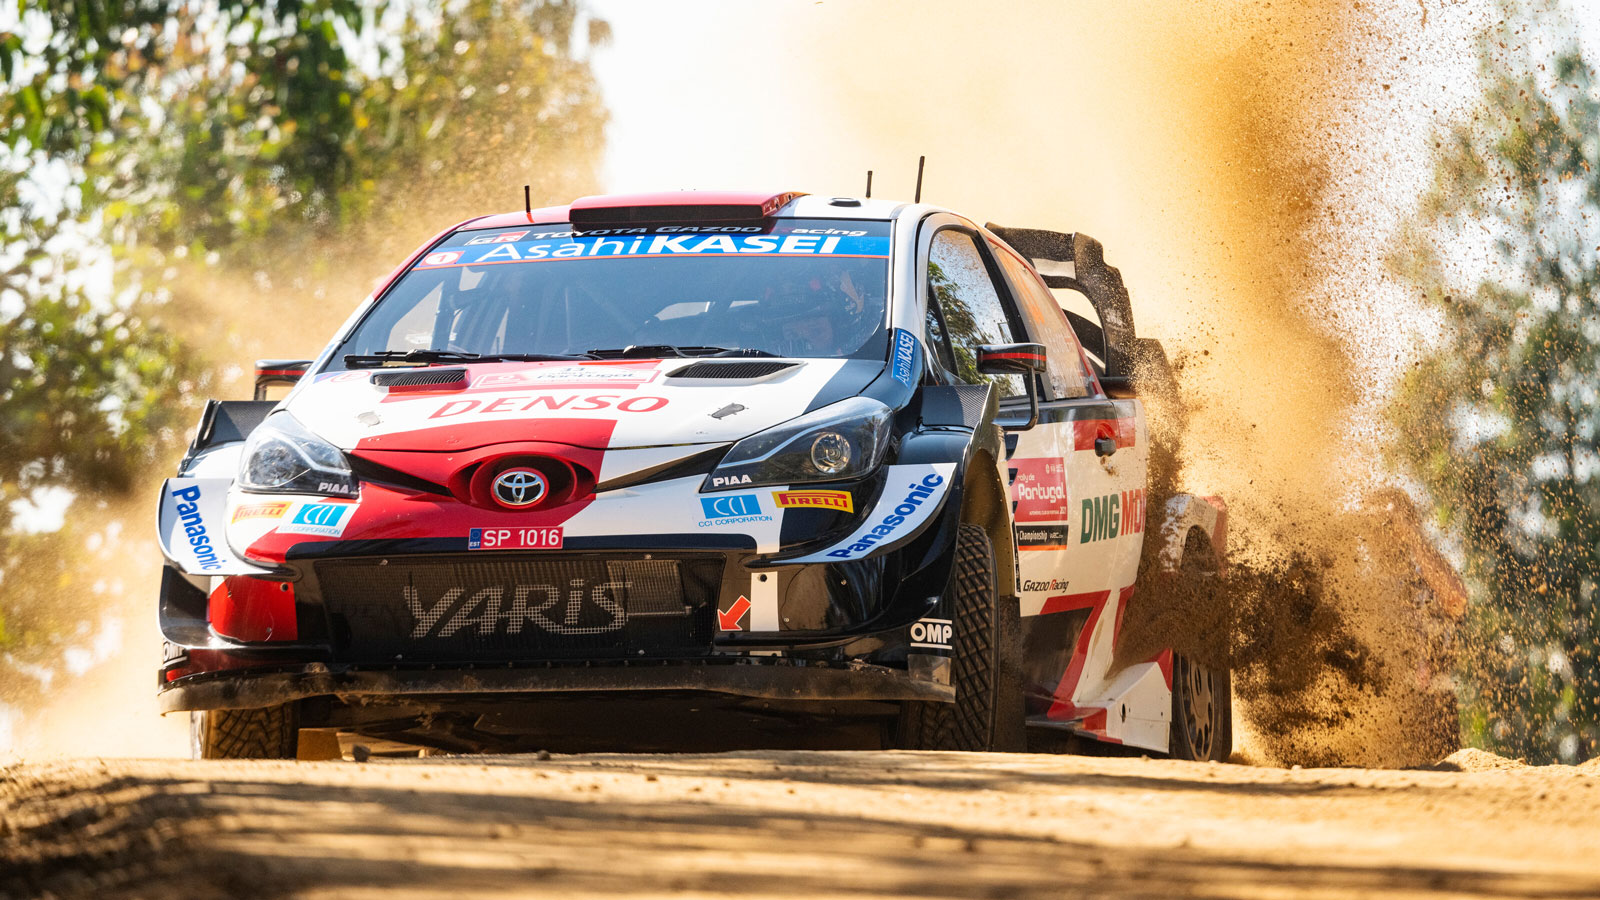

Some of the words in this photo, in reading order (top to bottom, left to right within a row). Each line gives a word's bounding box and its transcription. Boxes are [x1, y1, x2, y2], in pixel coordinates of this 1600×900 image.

[533, 227, 647, 239] TOYOTA
[656, 225, 763, 233] GAZOO
[428, 395, 670, 420] DENSO
[318, 482, 349, 494] PIAA
[713, 474, 753, 487] PIAA
[778, 491, 848, 508] PIRELLI
[1018, 482, 1066, 504] Portugal
[233, 503, 287, 521] PIRELLI
[303, 505, 337, 525] CCI
[713, 496, 748, 516] CCI
[698, 520, 713, 528] CCI
[715, 515, 773, 526] CORPORATION
[826, 473, 944, 558] Panasonic
[1080, 493, 1120, 545] DMG
[171, 485, 227, 571] Panasonic
[293, 526, 342, 536] CORPORATION
[1019, 530, 1048, 542] Championship
[483, 529, 511, 547] SP
[518, 529, 559, 546] 1016
[1023, 579, 1049, 592] GAZOO
[1049, 579, 1069, 593] Racing
[910, 622, 953, 644] OMP
